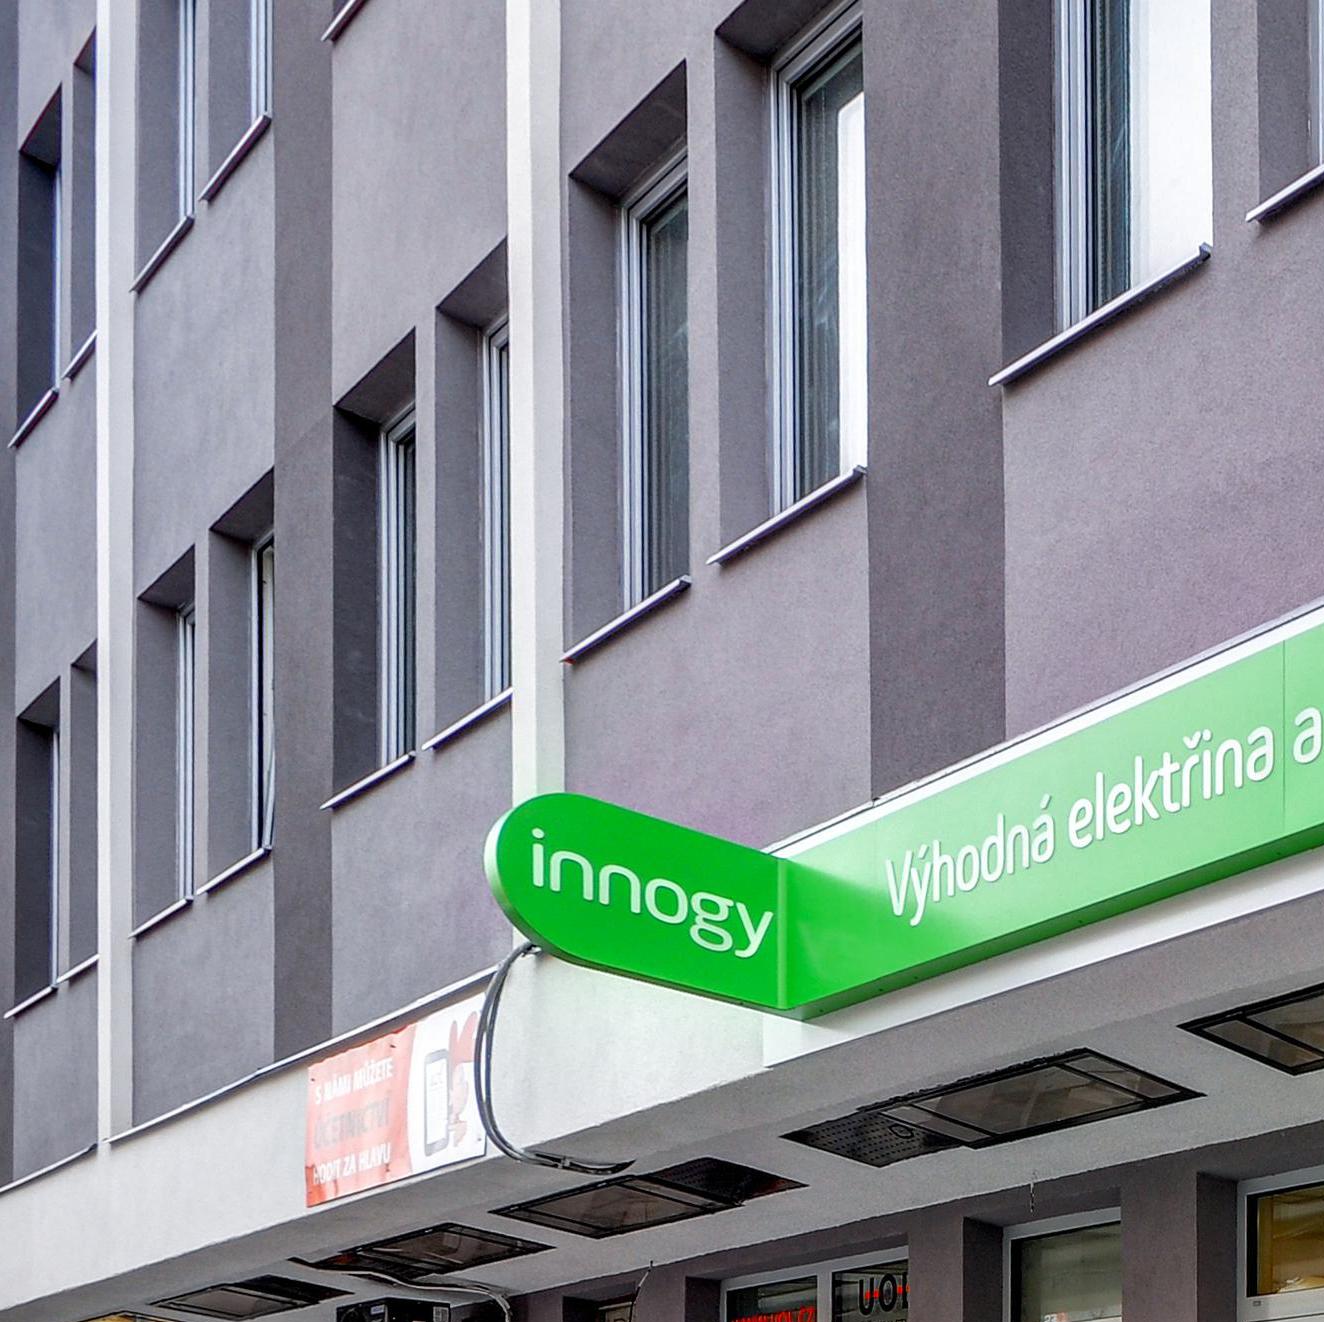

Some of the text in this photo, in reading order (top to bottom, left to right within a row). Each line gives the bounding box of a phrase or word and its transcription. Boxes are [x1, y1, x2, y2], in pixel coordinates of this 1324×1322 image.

[885, 793, 1054, 927] Výhodná
[1067, 722, 1275, 850] elektřina
[1292, 706, 1323, 765] a
[530, 827, 774, 960] innogy
[314, 1085, 323, 1105] S
[353, 1057, 394, 1091] MŮŽETE
[342, 1151, 357, 1177] ZA
[358, 1141, 392, 1172] HLAVU
